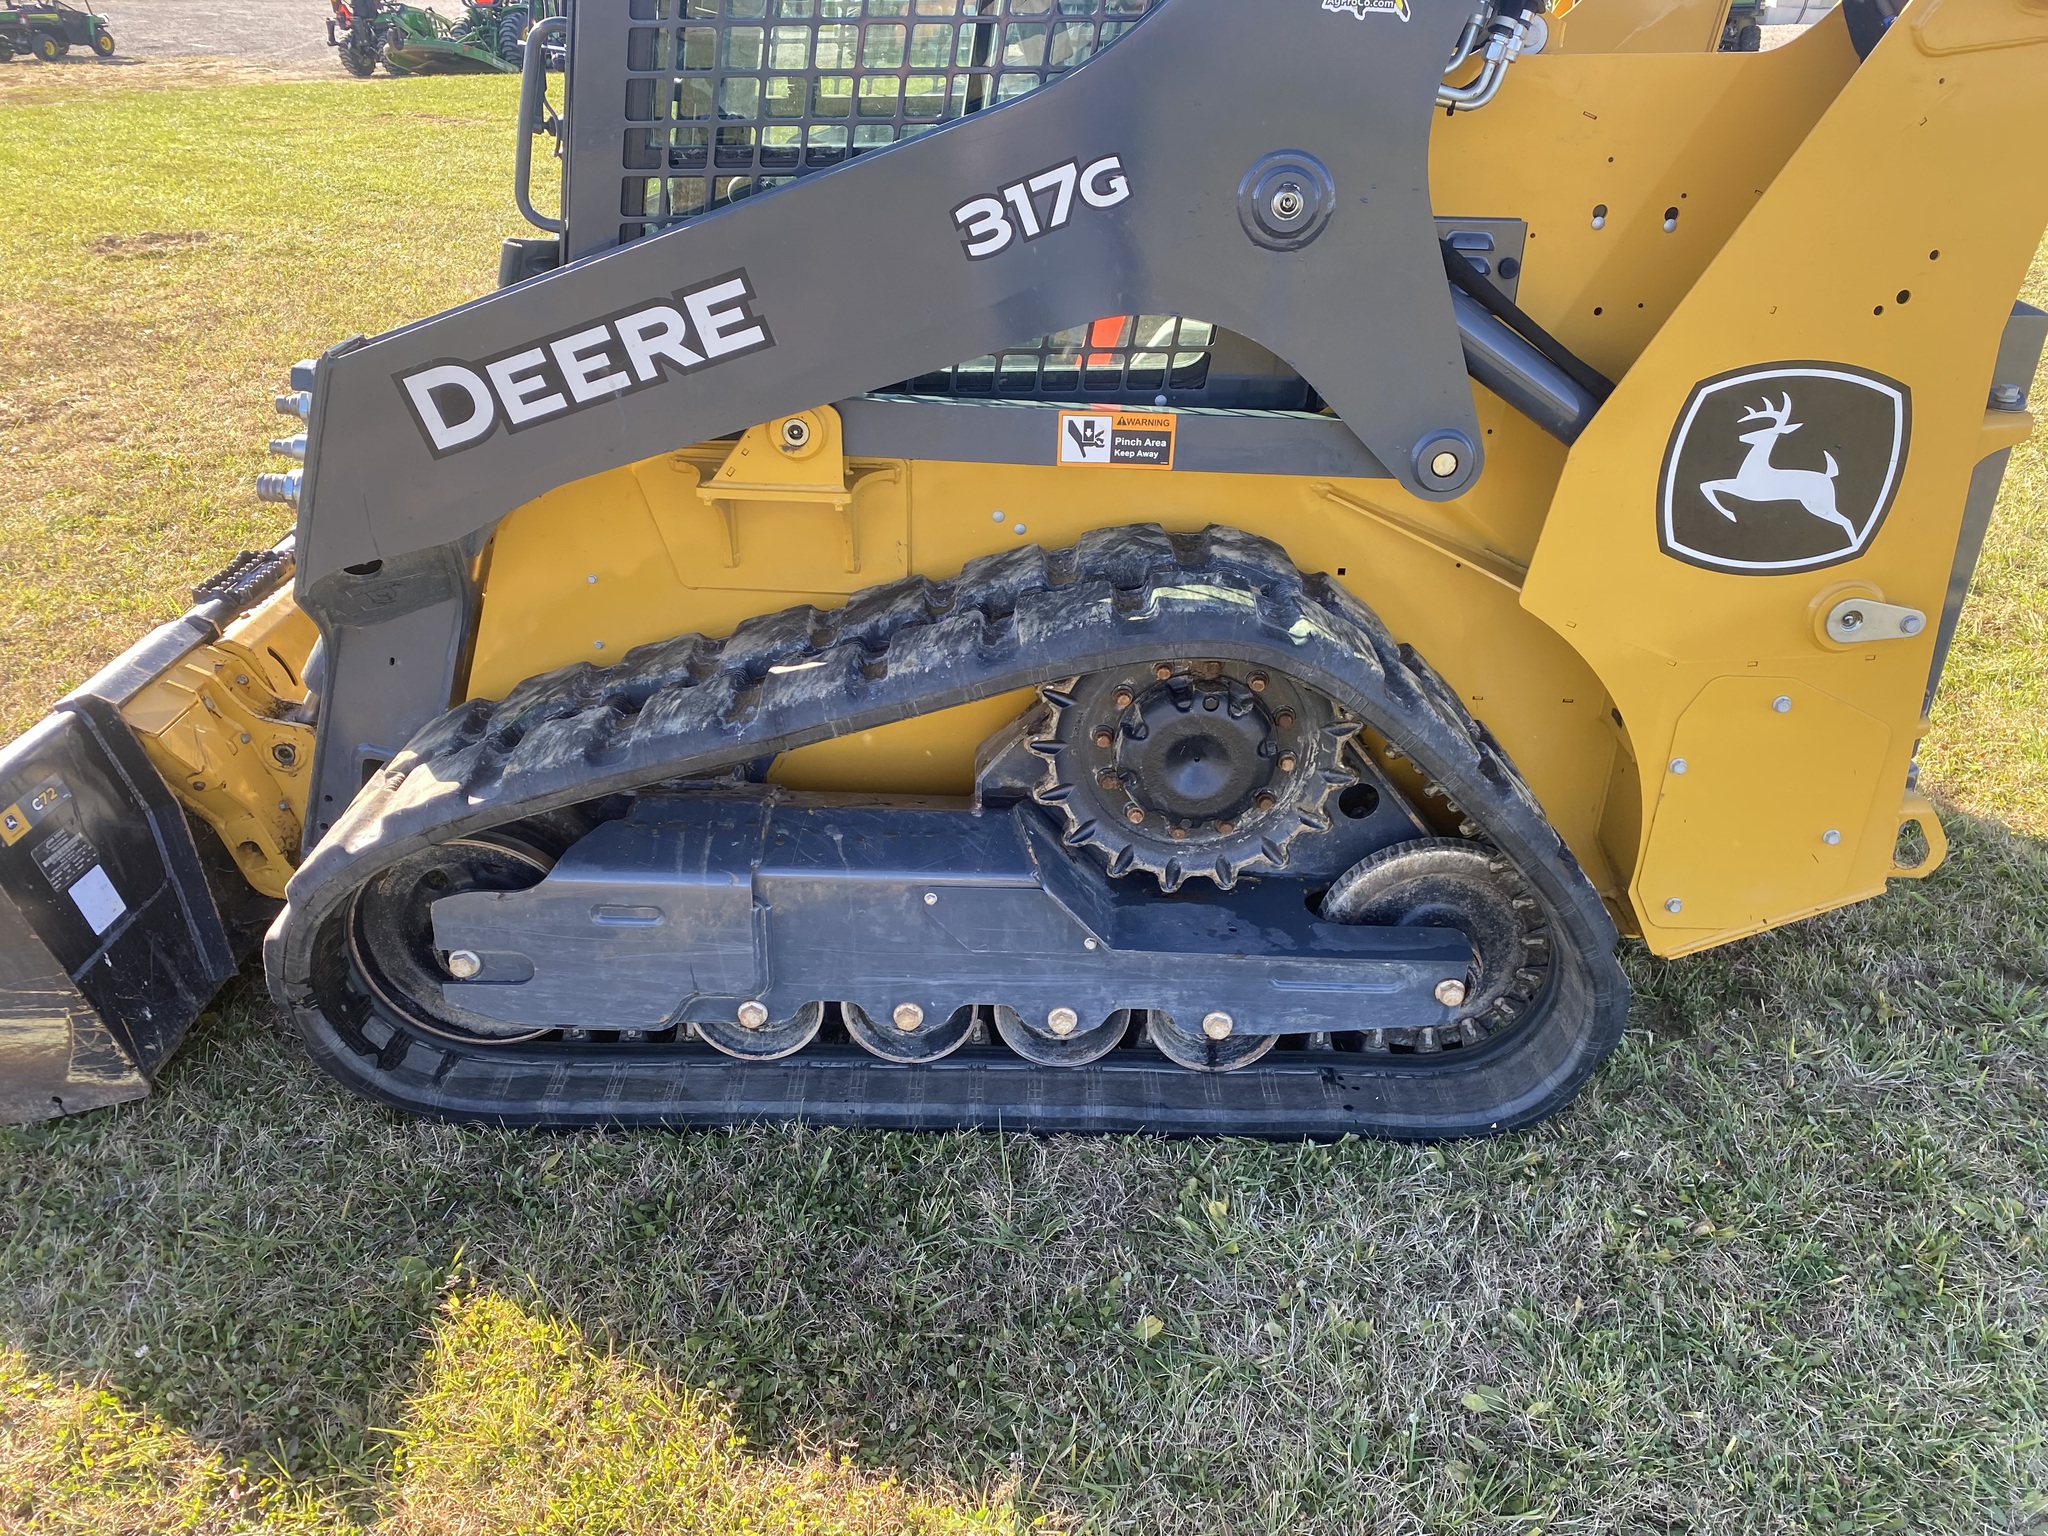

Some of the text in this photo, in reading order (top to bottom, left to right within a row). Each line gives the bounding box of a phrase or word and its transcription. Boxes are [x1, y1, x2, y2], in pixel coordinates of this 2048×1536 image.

[955, 156, 1130, 256] 317G
[402, 277, 766, 450] DEERE
[1126, 418, 1170, 427] WARNING
[1115, 437, 1167, 447] Pinch Area
[1114, 449, 1159, 460] Keep Away
[32, 787, 58, 811] C72
